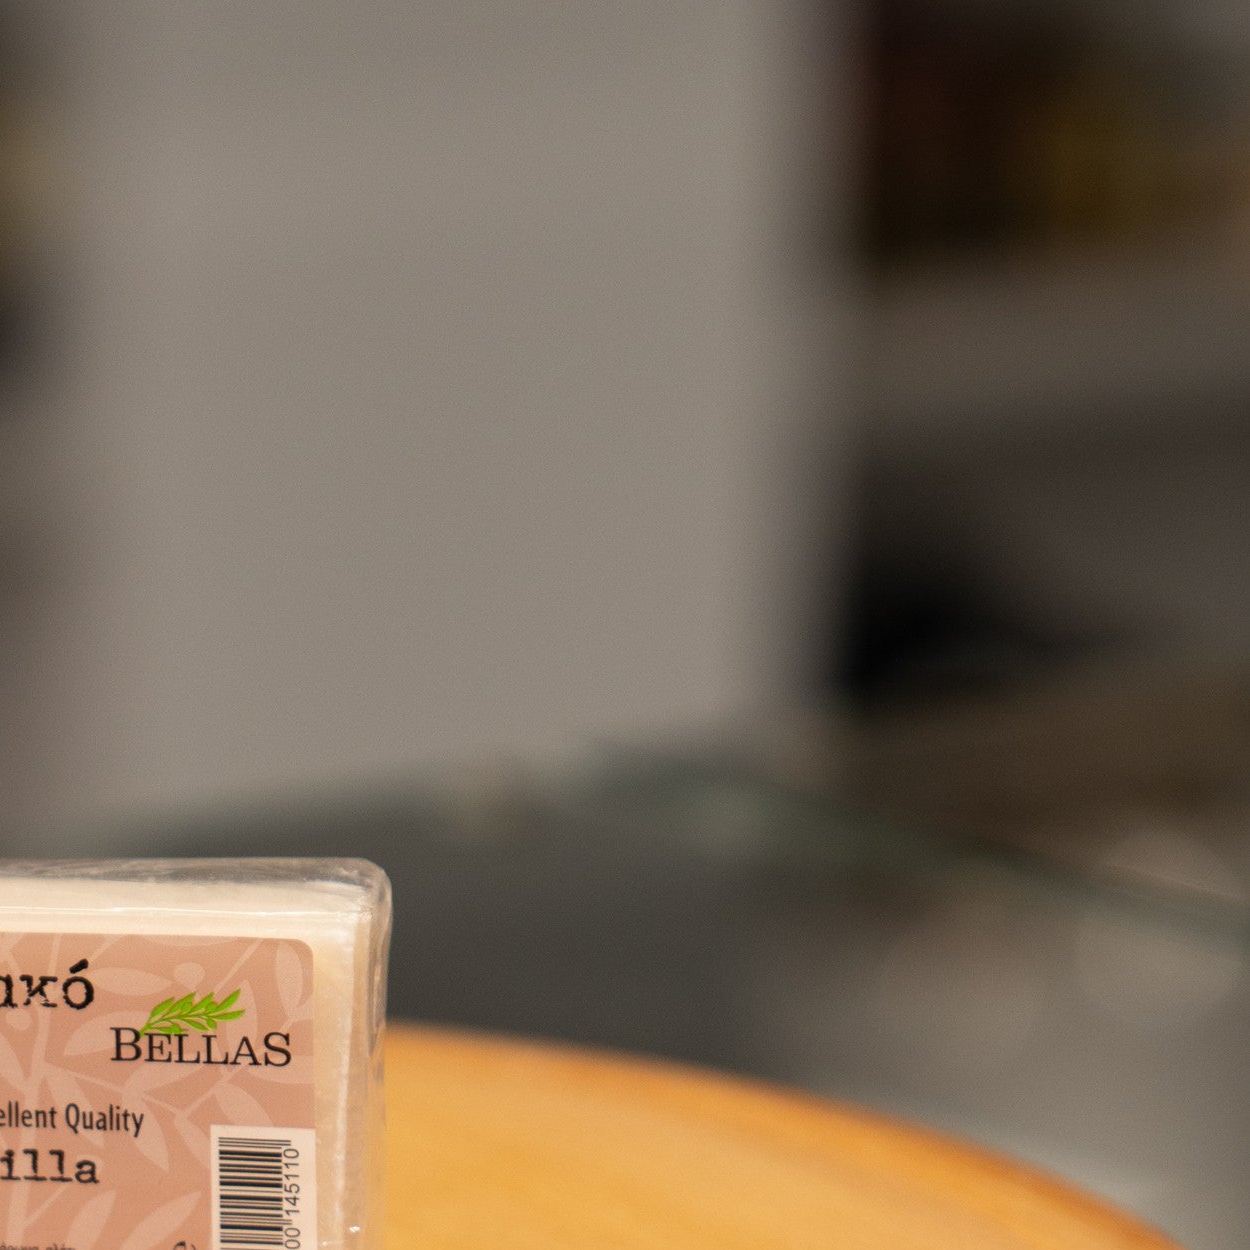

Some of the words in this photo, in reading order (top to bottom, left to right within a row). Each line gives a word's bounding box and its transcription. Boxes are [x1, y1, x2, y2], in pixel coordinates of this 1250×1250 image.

[110, 1026, 292, 1067] BELLAS
[65, 1103, 144, 1138] Quality
[283, 1148, 300, 1216] 145110
